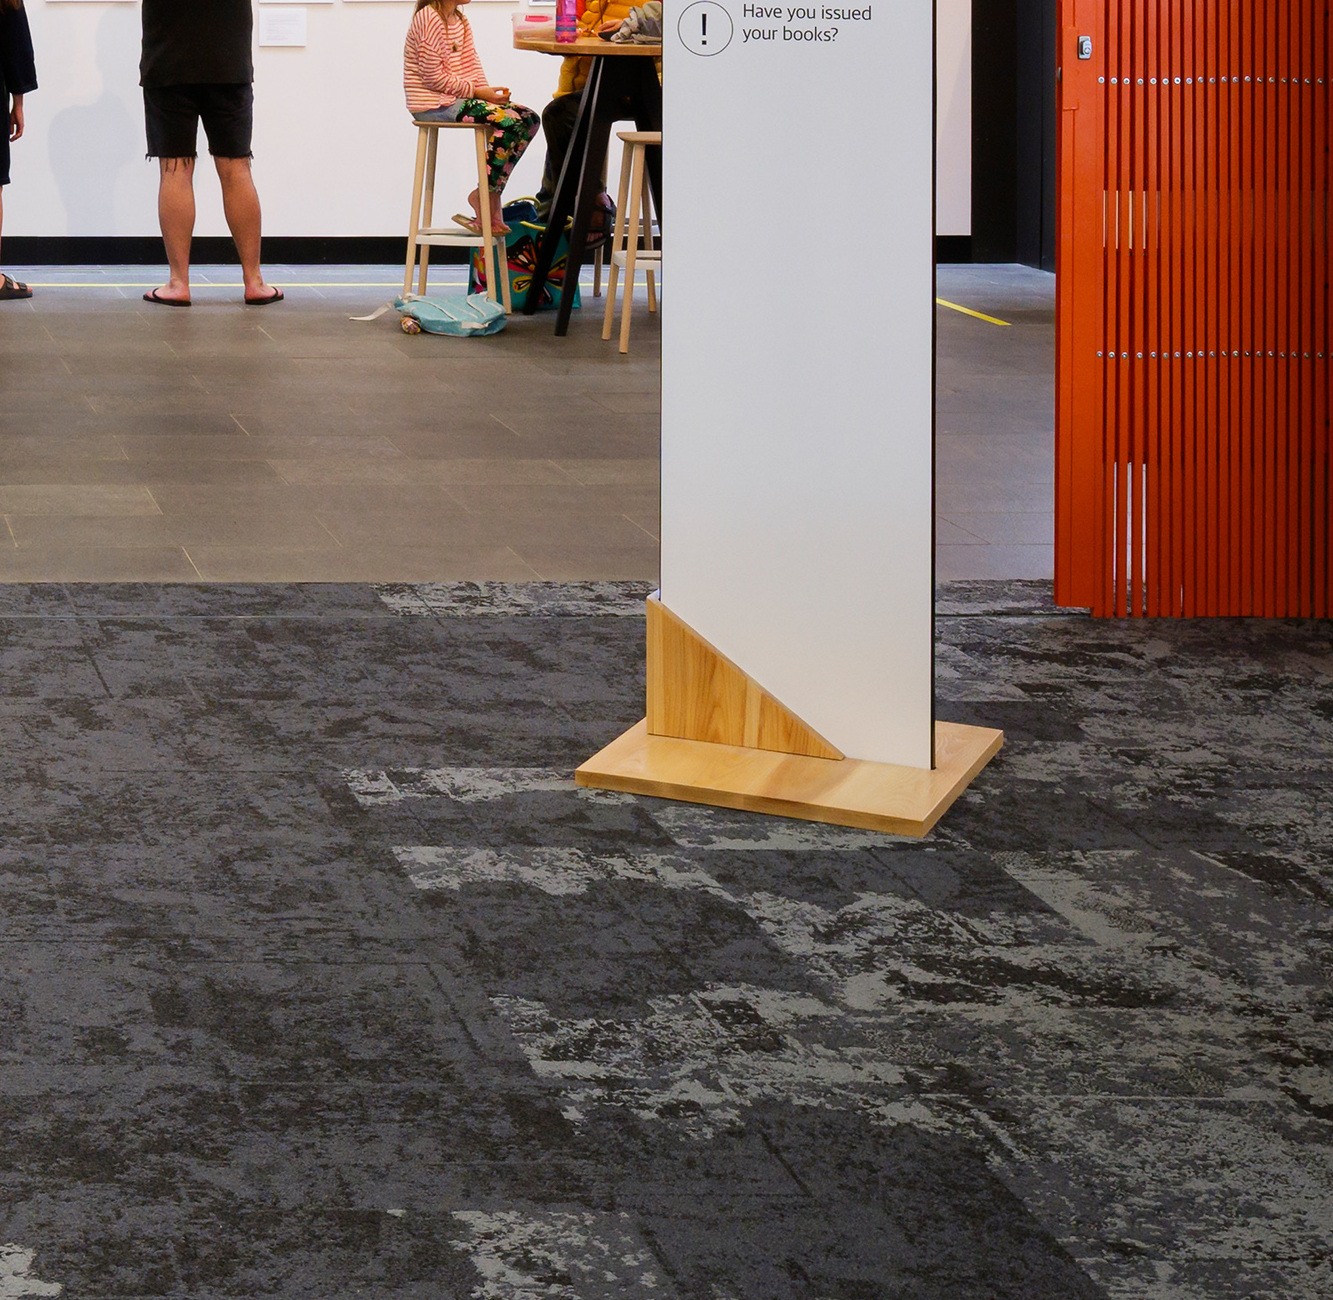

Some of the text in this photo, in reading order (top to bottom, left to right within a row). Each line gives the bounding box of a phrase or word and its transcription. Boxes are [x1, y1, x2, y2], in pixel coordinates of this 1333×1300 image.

[742, 3, 872, 23] Have you issued
[742, 26, 839, 43] your books?
